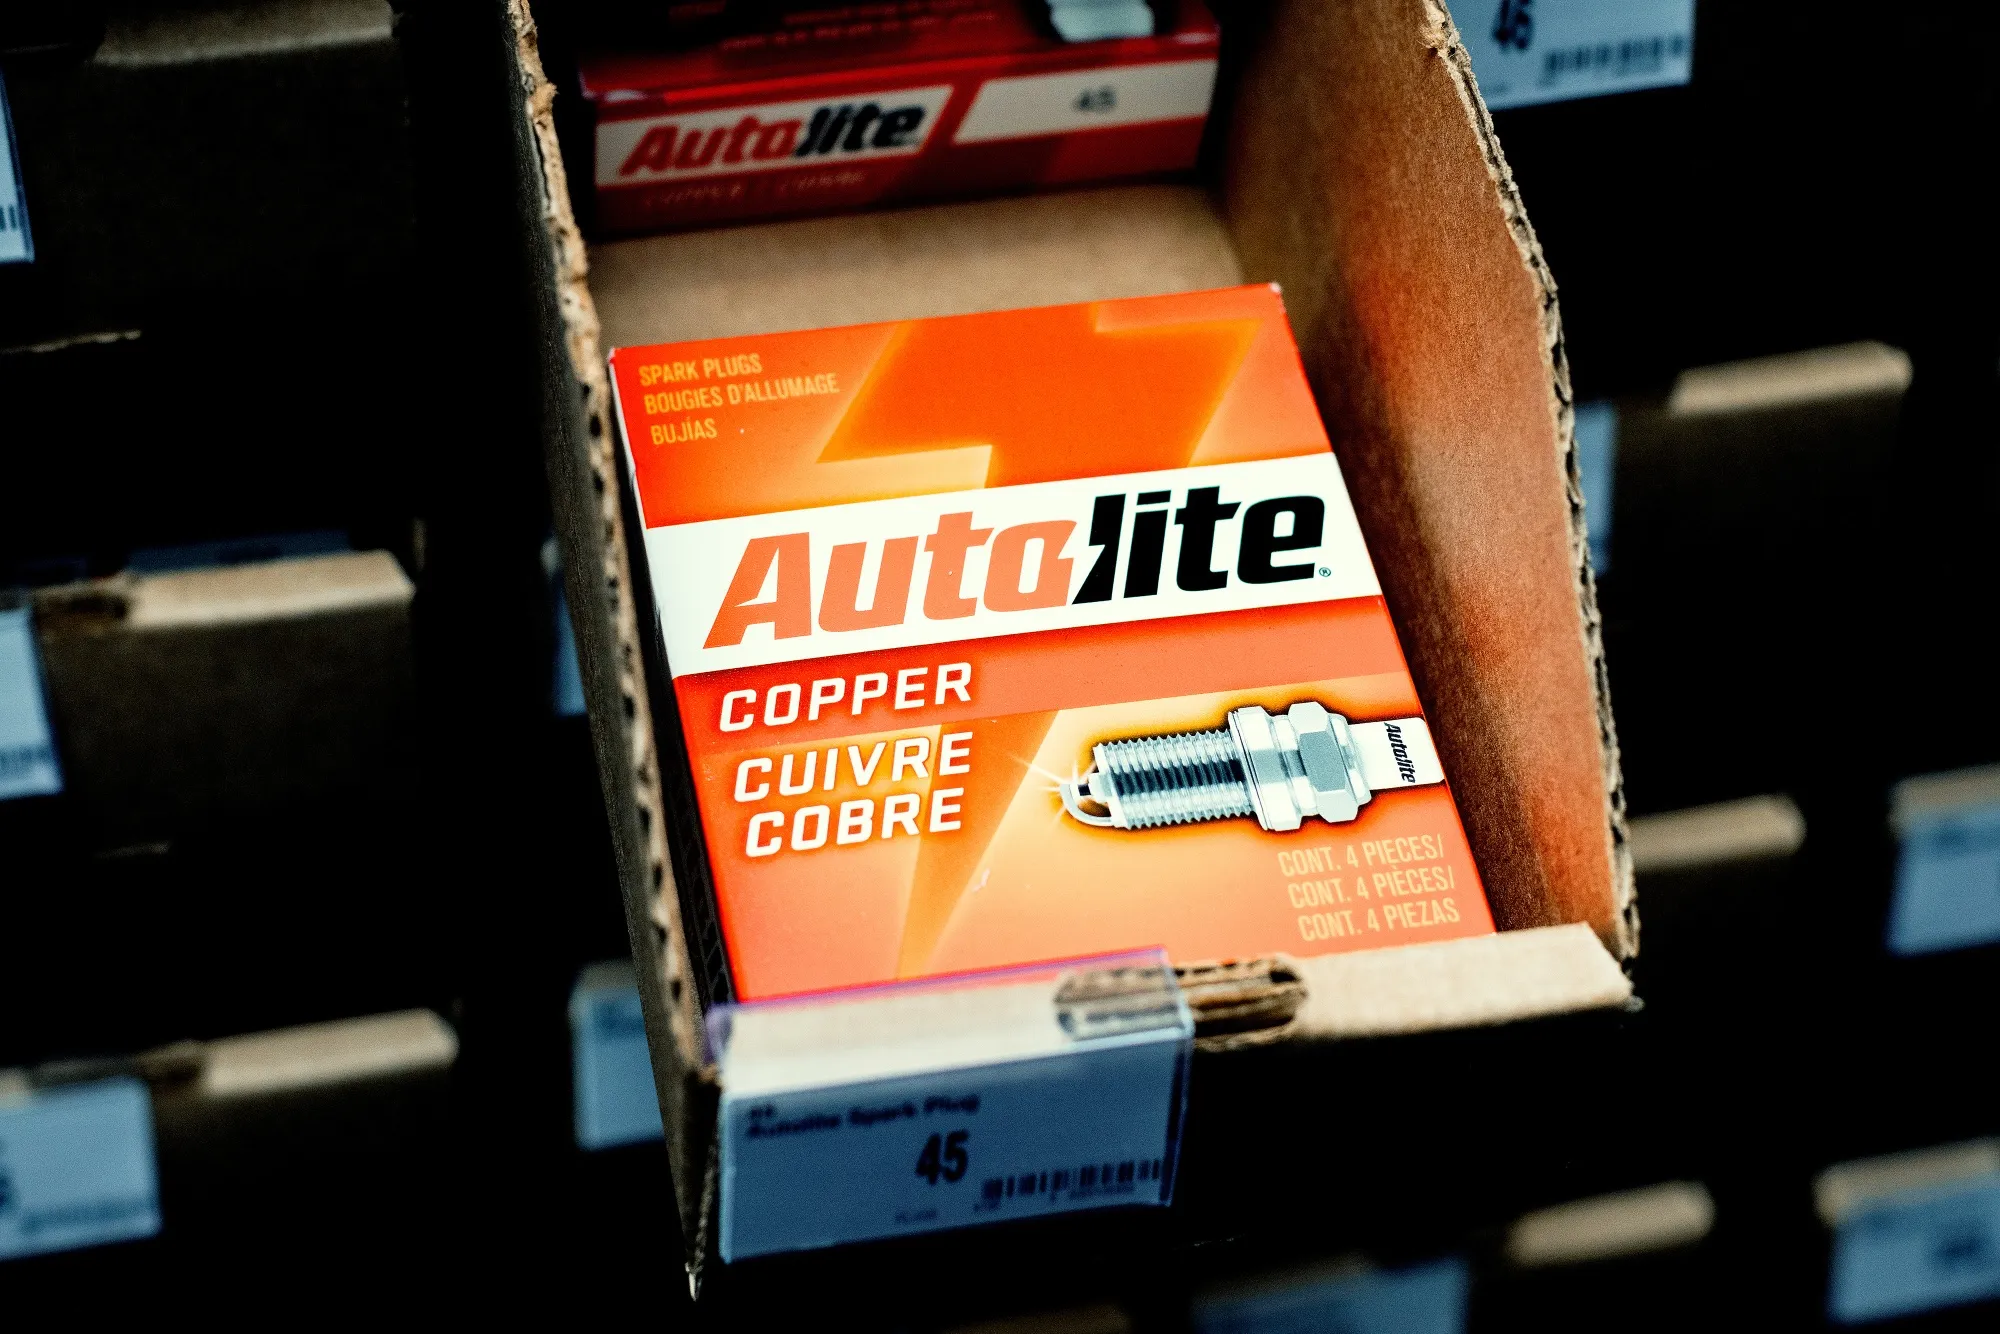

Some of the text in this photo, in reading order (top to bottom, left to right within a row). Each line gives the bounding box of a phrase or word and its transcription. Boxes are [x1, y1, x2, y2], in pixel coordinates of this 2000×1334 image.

[620, 102, 925, 176] Autolite
[639, 353, 763, 387] SPARK PLUGS
[644, 372, 840, 415] BOUGIES D'ALLUMAGE
[651, 416, 717, 446] BUJÍAS
[703, 485, 1326, 650] Autolite
[719, 661, 973, 733] COPPER
[734, 731, 973, 803] CUIVRE
[1384, 721, 1416, 783] Autolite
[745, 787, 963, 858] COBRE
[1277, 846, 1342, 877] CONT.
[1346, 845, 1359, 868] 4
[1287, 877, 1352, 909] CONT.
[1356, 876, 1369, 900] 4
[1297, 897, 1460, 941] CONT. 4 PIEZAS
[848, 1101, 917, 1127] Spark
[924, 1093, 980, 1116] Plug
[915, 1128, 970, 1185] 45
